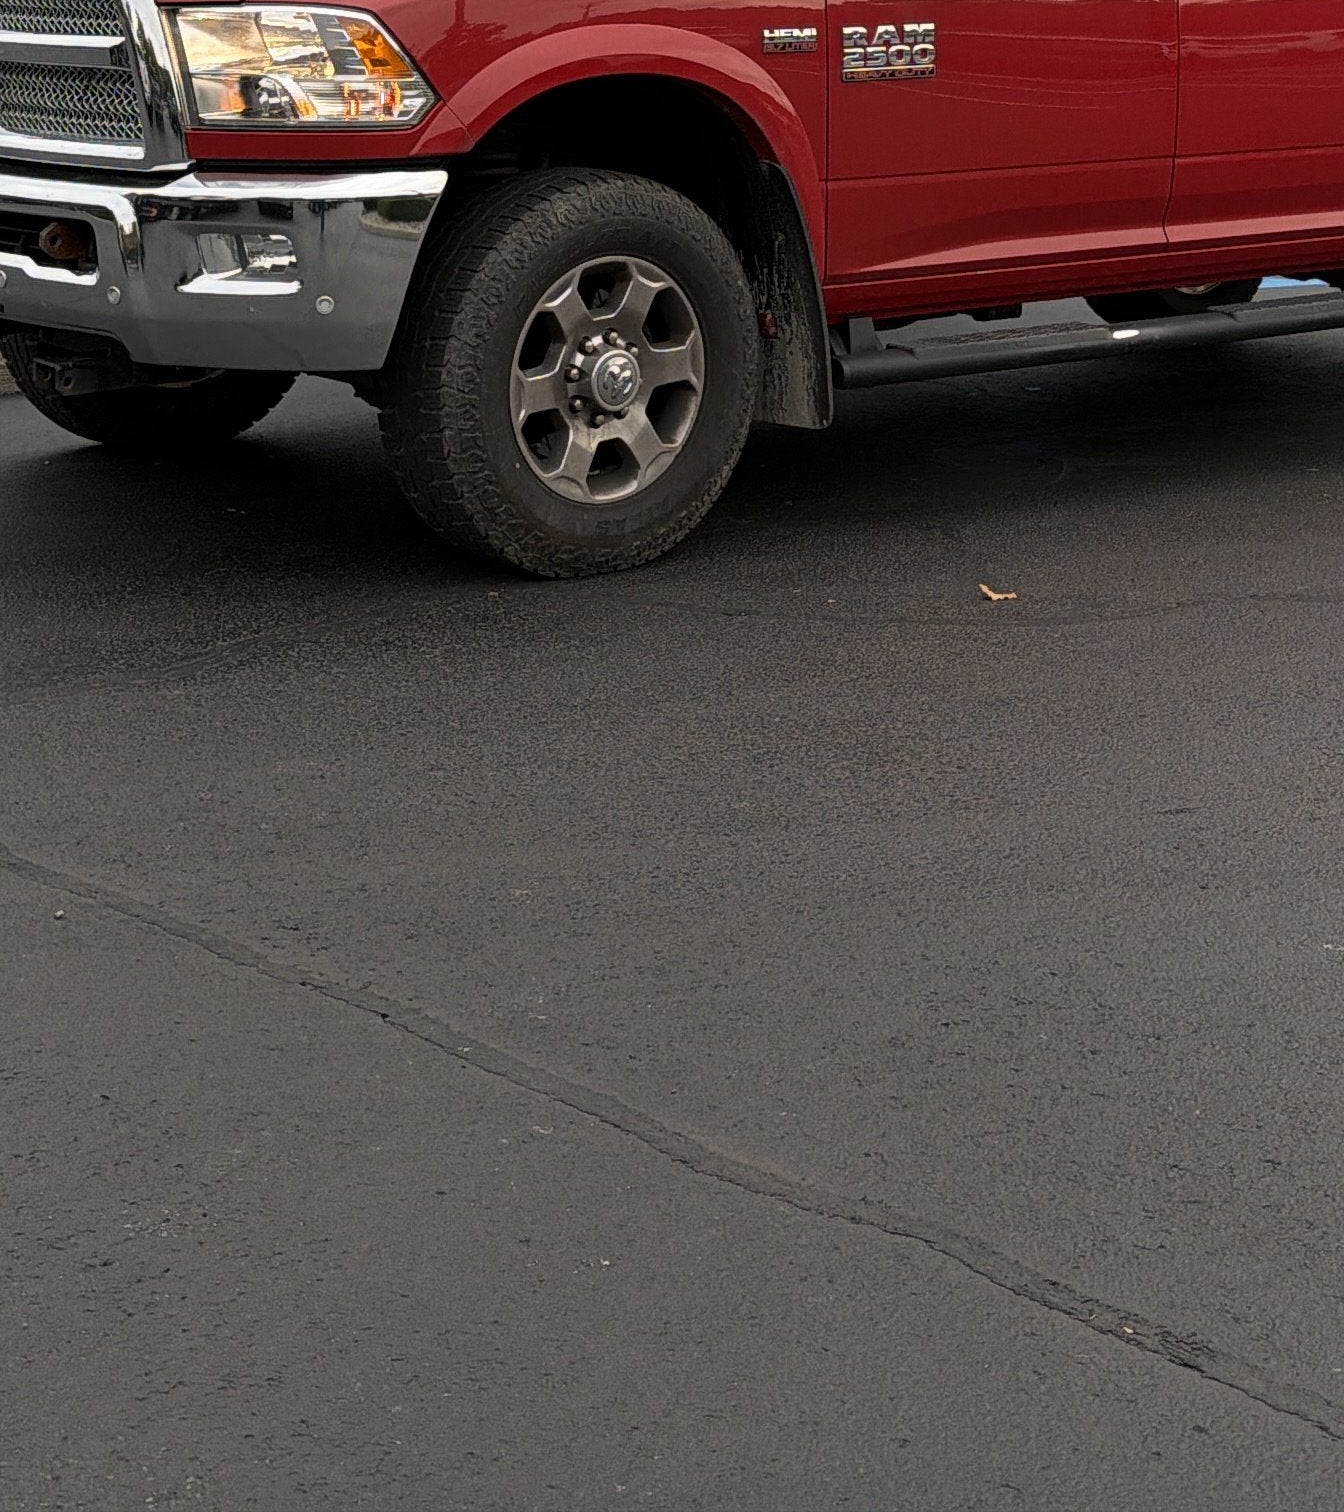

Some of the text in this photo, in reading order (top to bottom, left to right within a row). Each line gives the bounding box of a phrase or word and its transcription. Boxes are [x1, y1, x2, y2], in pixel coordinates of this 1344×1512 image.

[763, 28, 817, 42] HEMI
[842, 23, 935, 46] RAM
[843, 43, 935, 68] 2500
